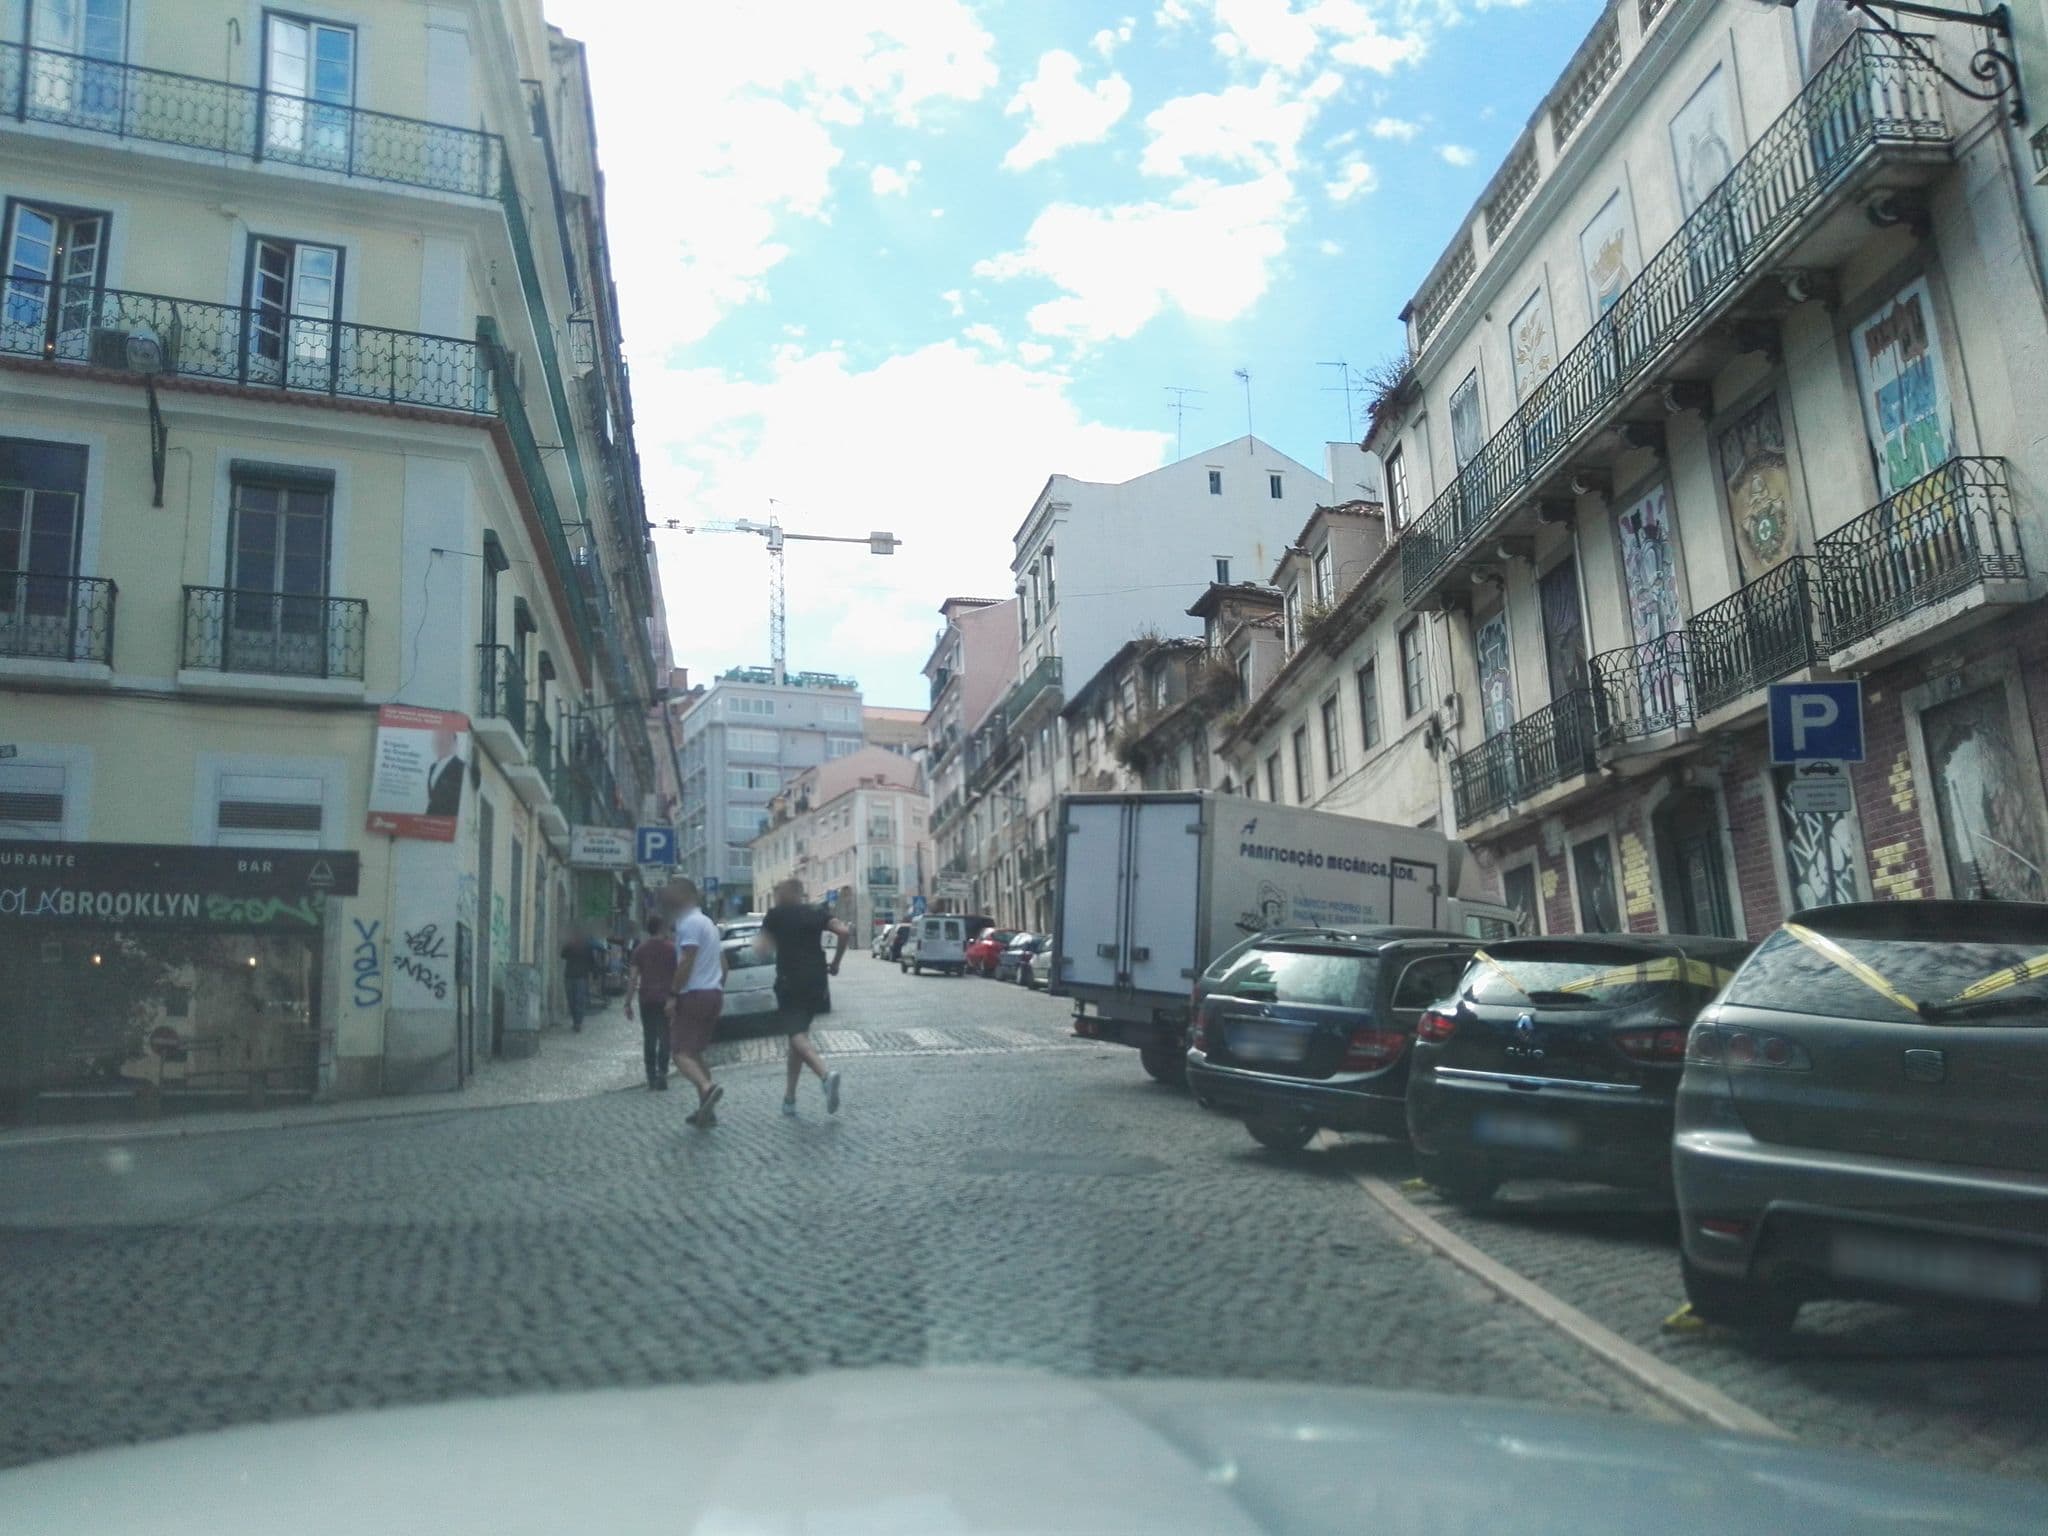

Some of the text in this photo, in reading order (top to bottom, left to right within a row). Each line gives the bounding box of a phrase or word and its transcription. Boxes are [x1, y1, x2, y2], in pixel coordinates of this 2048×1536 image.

[1790, 693, 1840, 752] P
[1240, 818, 1258, 836] A
[645, 831, 667, 860] P
[237, 860, 273, 873] BAR
[59, 891, 200, 918] BROOKLYN
